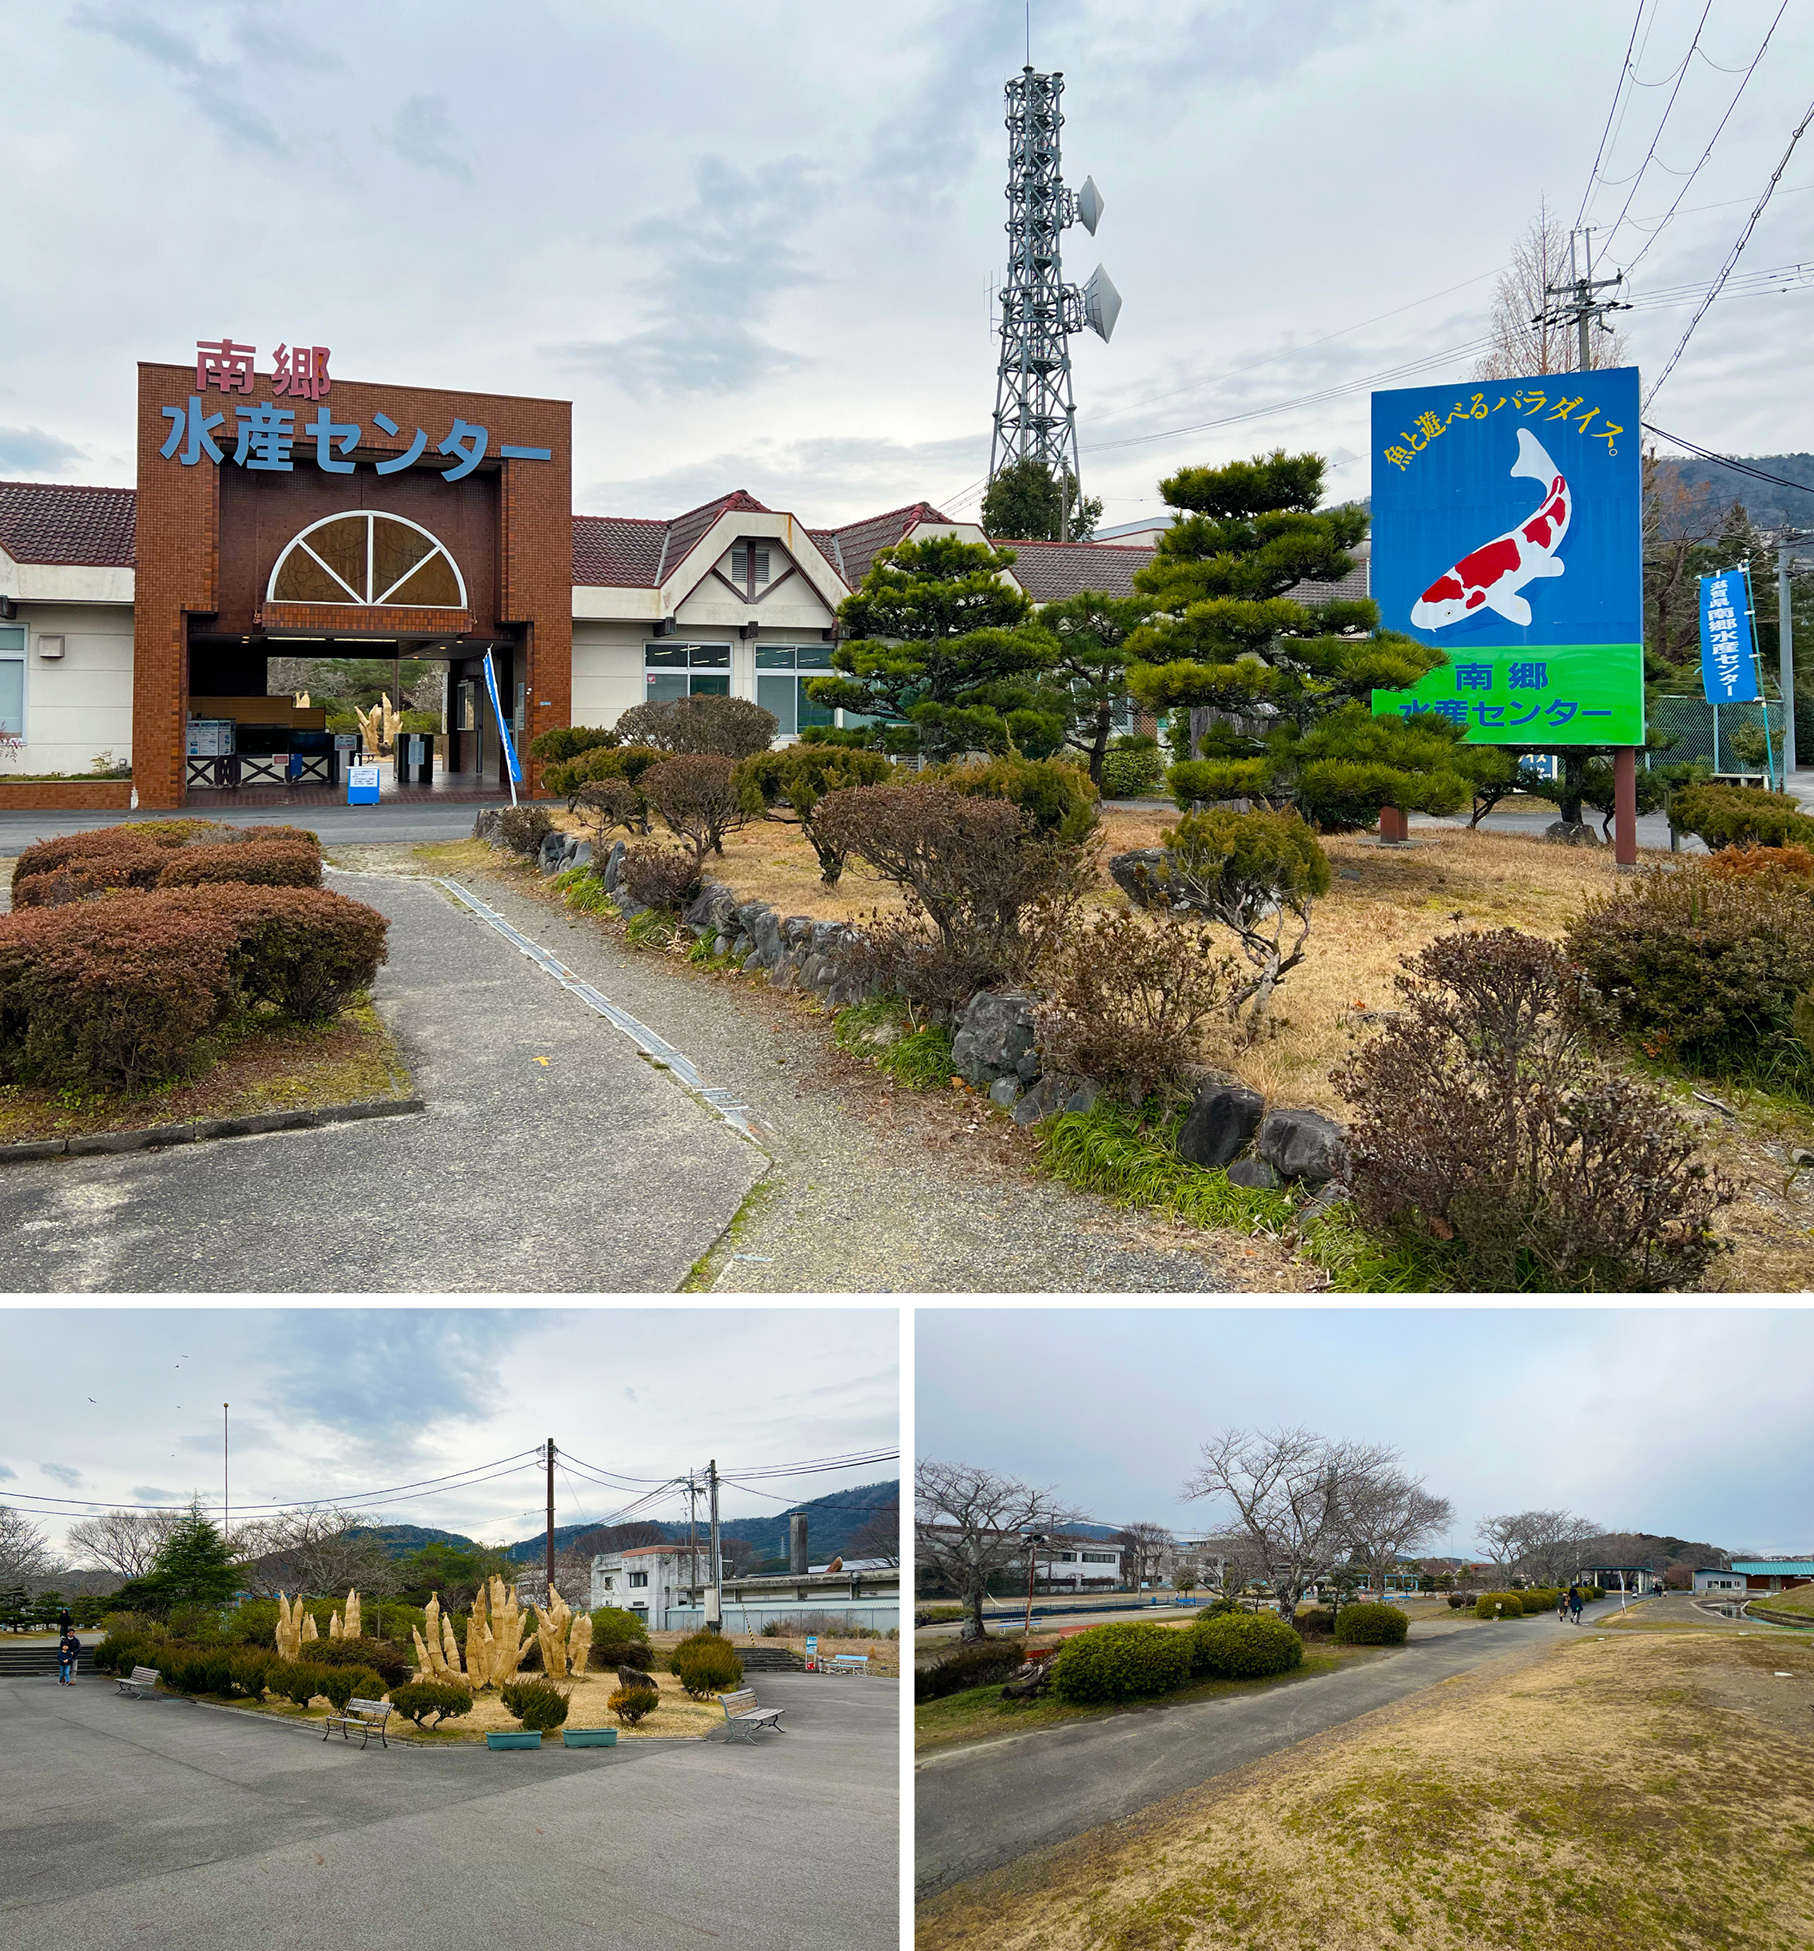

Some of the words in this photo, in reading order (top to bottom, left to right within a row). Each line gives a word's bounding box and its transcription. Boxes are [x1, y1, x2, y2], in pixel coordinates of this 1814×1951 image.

[197, 338, 331, 401] 南郷
[159, 396, 552, 482] 水産センター
[1383, 389, 1624, 472] 魚と遊べるパラダイス。
[1455, 661, 1549, 691] 南郷
